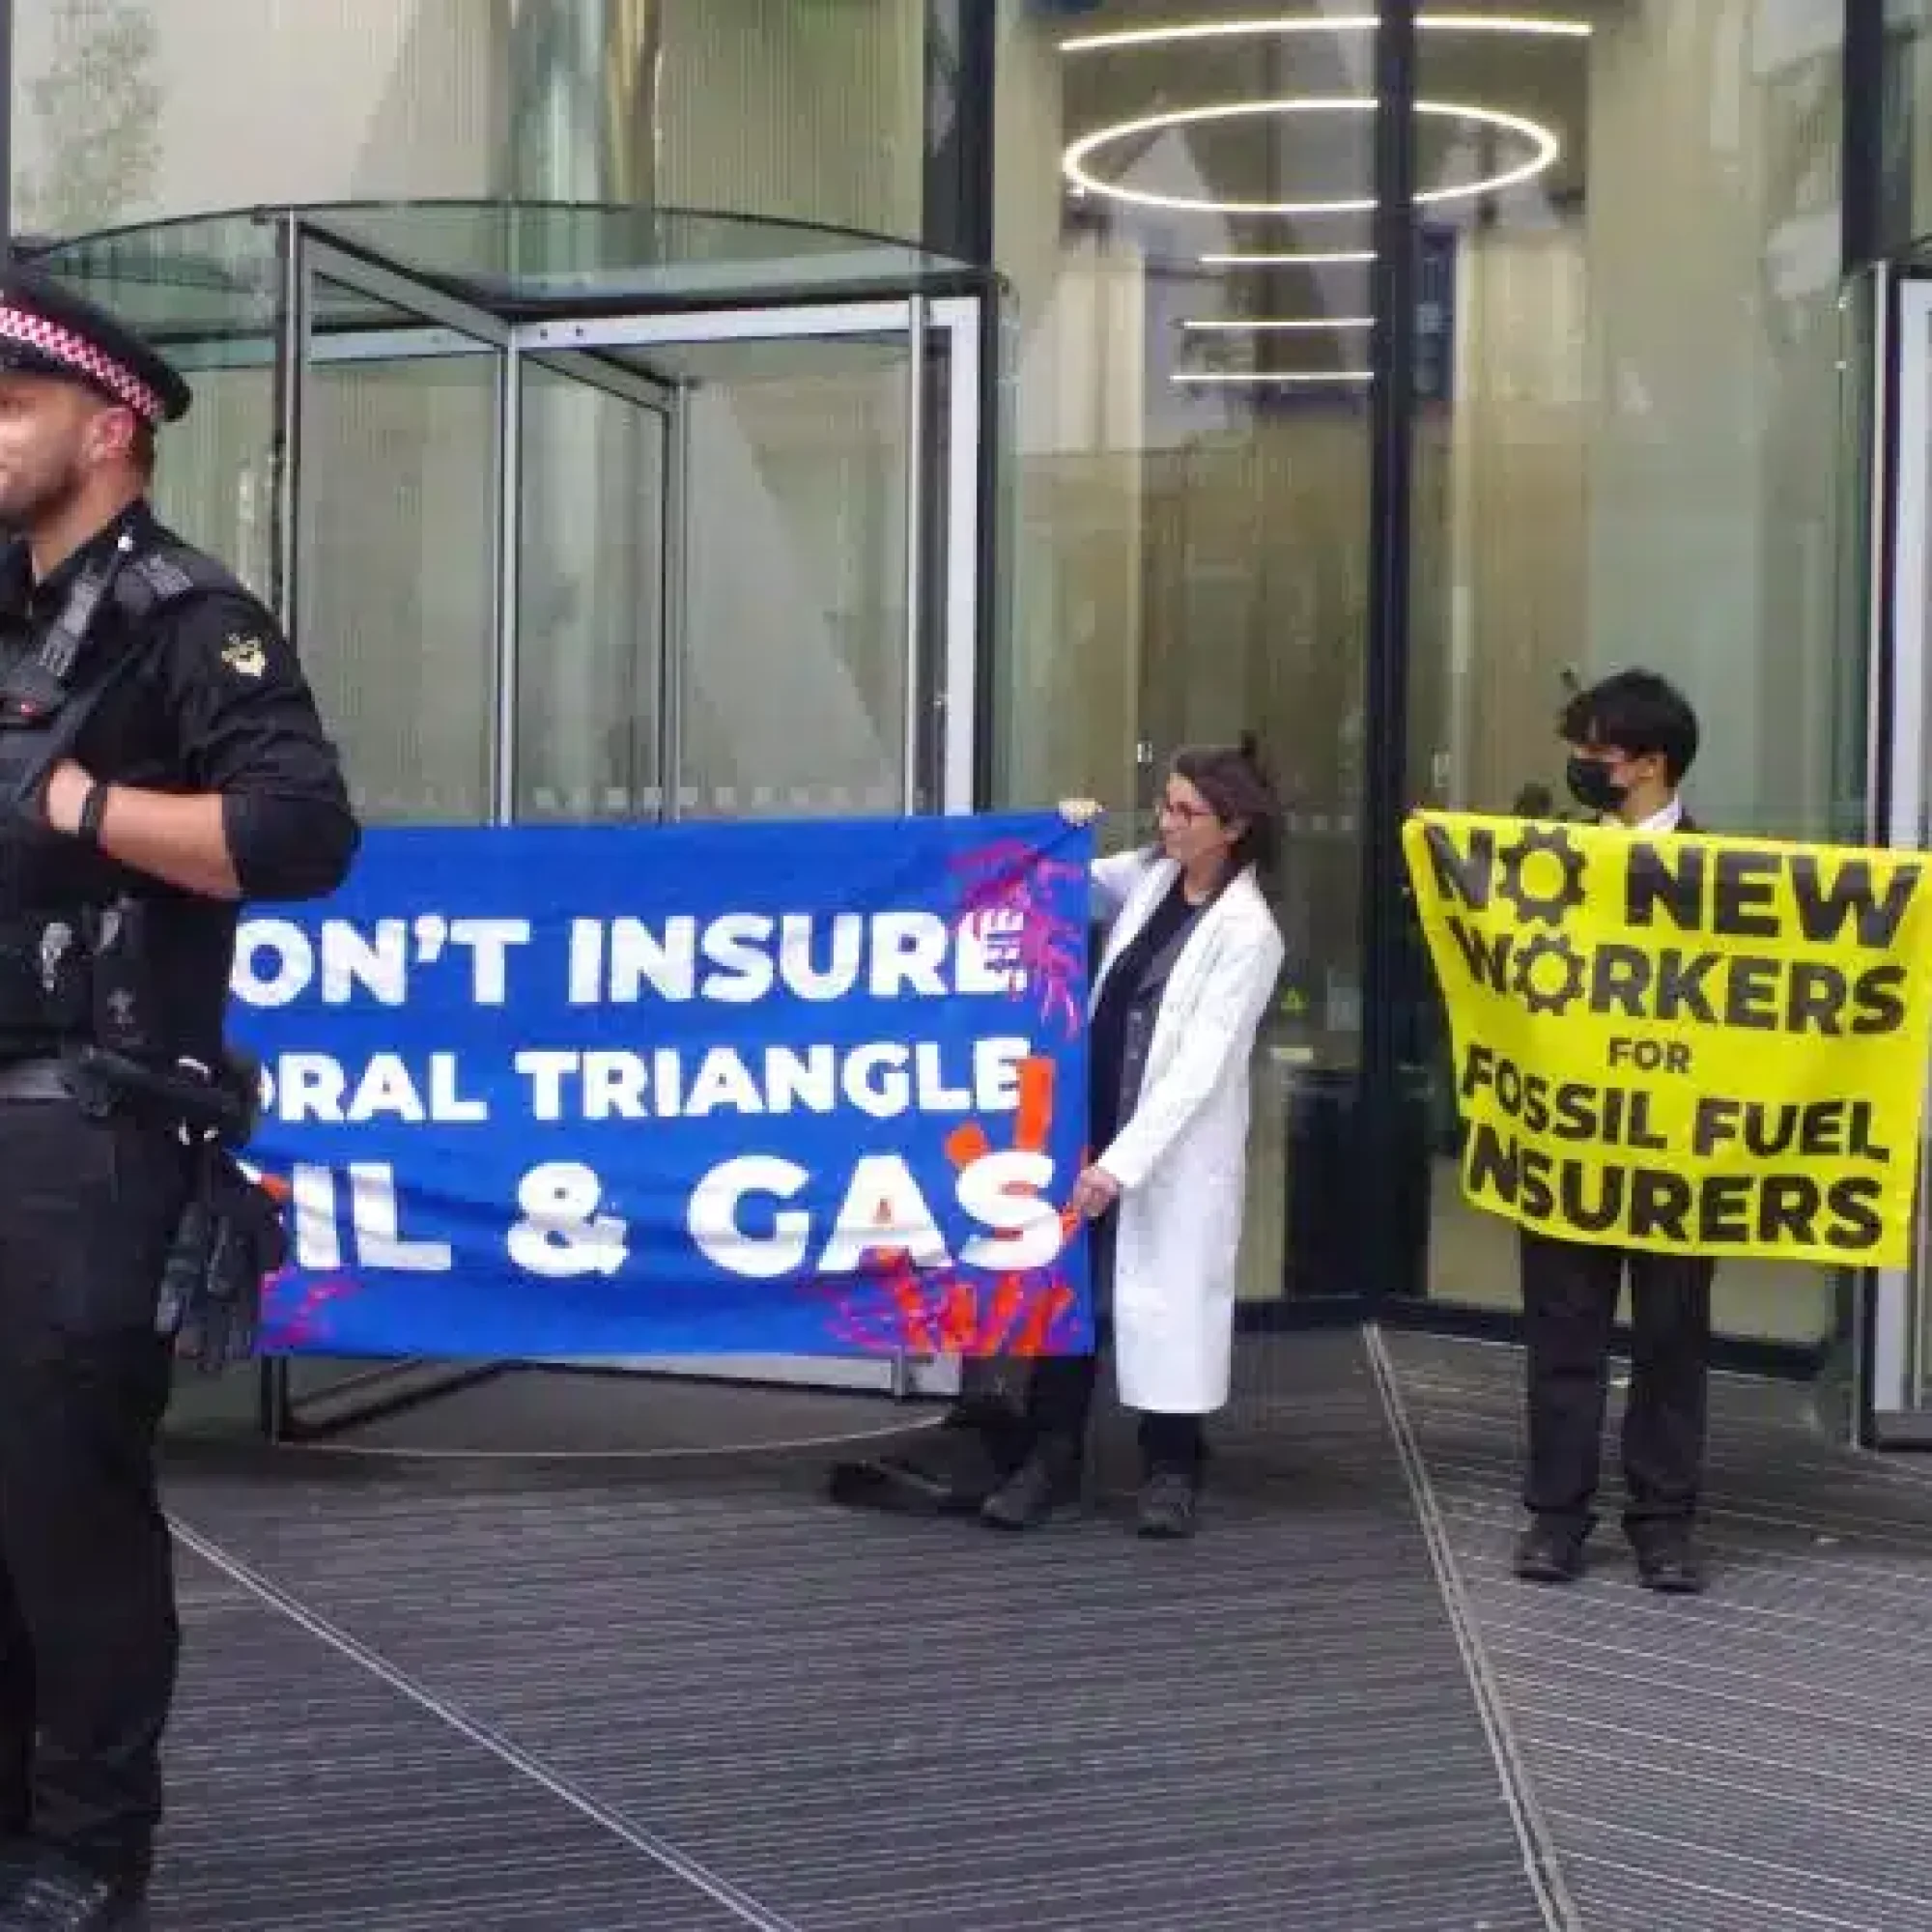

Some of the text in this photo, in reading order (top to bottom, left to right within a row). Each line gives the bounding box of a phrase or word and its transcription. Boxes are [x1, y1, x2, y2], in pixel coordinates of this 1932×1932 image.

[1424, 826, 1921, 949] NO NEW
[229, 909, 1028, 1006] ON'T INSURE
[1445, 916, 1907, 1037] WORKERS
[515, 1037, 1032, 1121] TRIANGLE
[1463, 1044, 1890, 1163] FOSSIL FUEL
[1607, 1037, 1692, 1074] FOR
[290, 1154, 1063, 1278] IL & GAS
